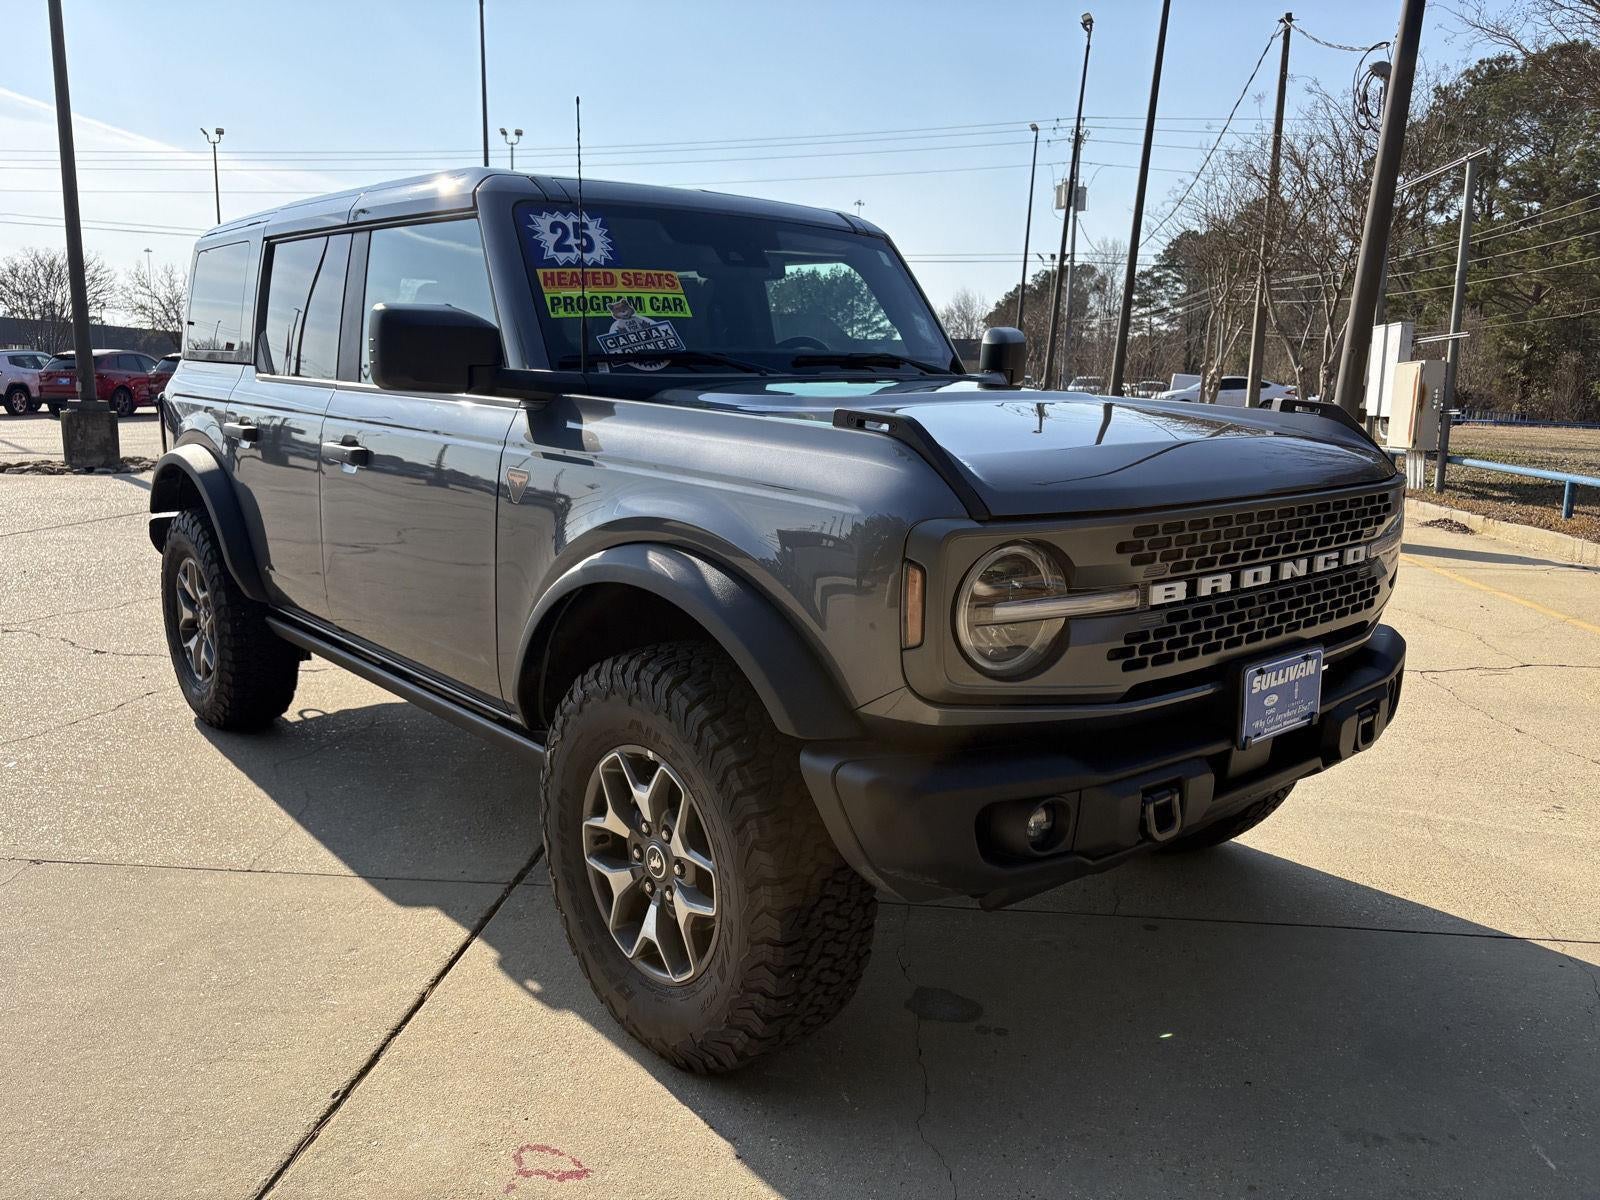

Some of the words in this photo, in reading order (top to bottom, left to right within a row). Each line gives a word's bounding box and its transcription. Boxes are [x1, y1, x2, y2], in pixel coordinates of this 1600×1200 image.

[549, 221, 595, 254] 25
[543, 271, 617, 289] HEATED
[621, 272, 678, 289] SEATS
[650, 298, 686, 314] CAR
[606, 328, 671, 348] CARFAX
[1149, 545, 1367, 605] BRONCO
[1252, 659, 1318, 694] SULLIVAN
